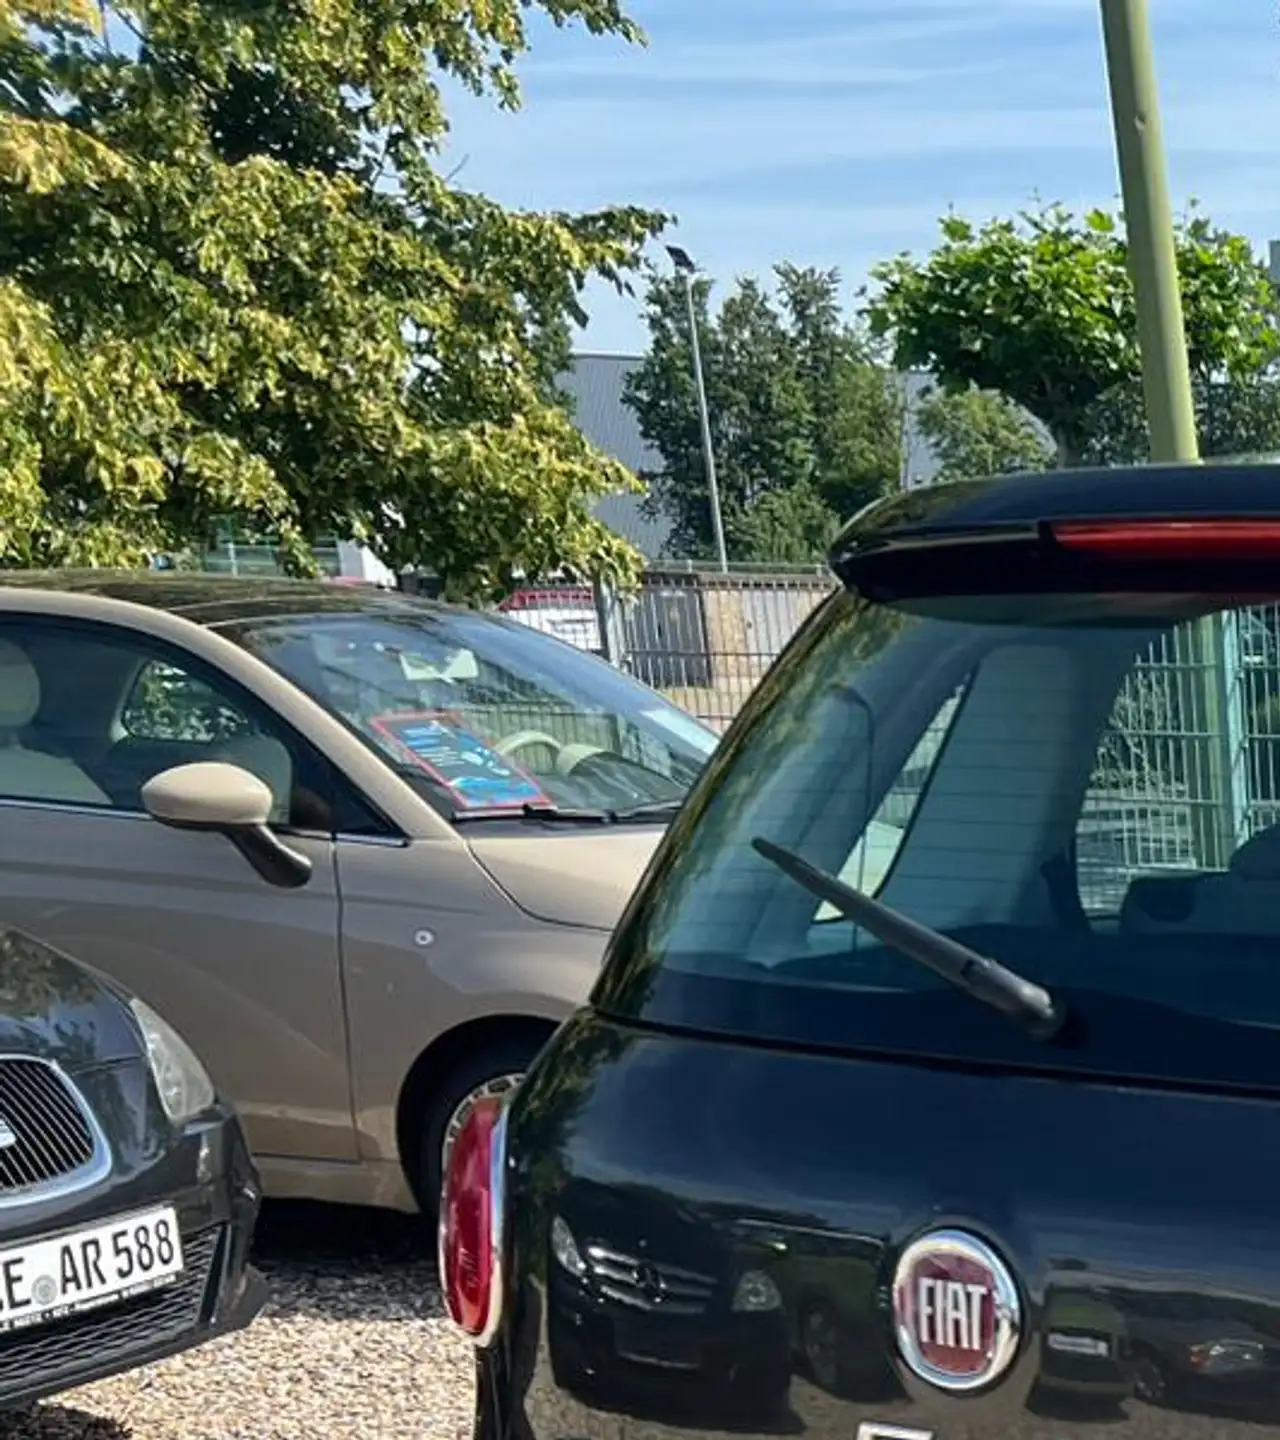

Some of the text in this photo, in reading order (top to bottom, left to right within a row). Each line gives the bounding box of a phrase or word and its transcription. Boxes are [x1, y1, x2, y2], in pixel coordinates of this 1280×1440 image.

[0, 1256, 32, 1310] E
[60, 1237, 107, 1295] AR
[111, 1218, 174, 1279] 588
[918, 1276, 988, 1350] FIAT
